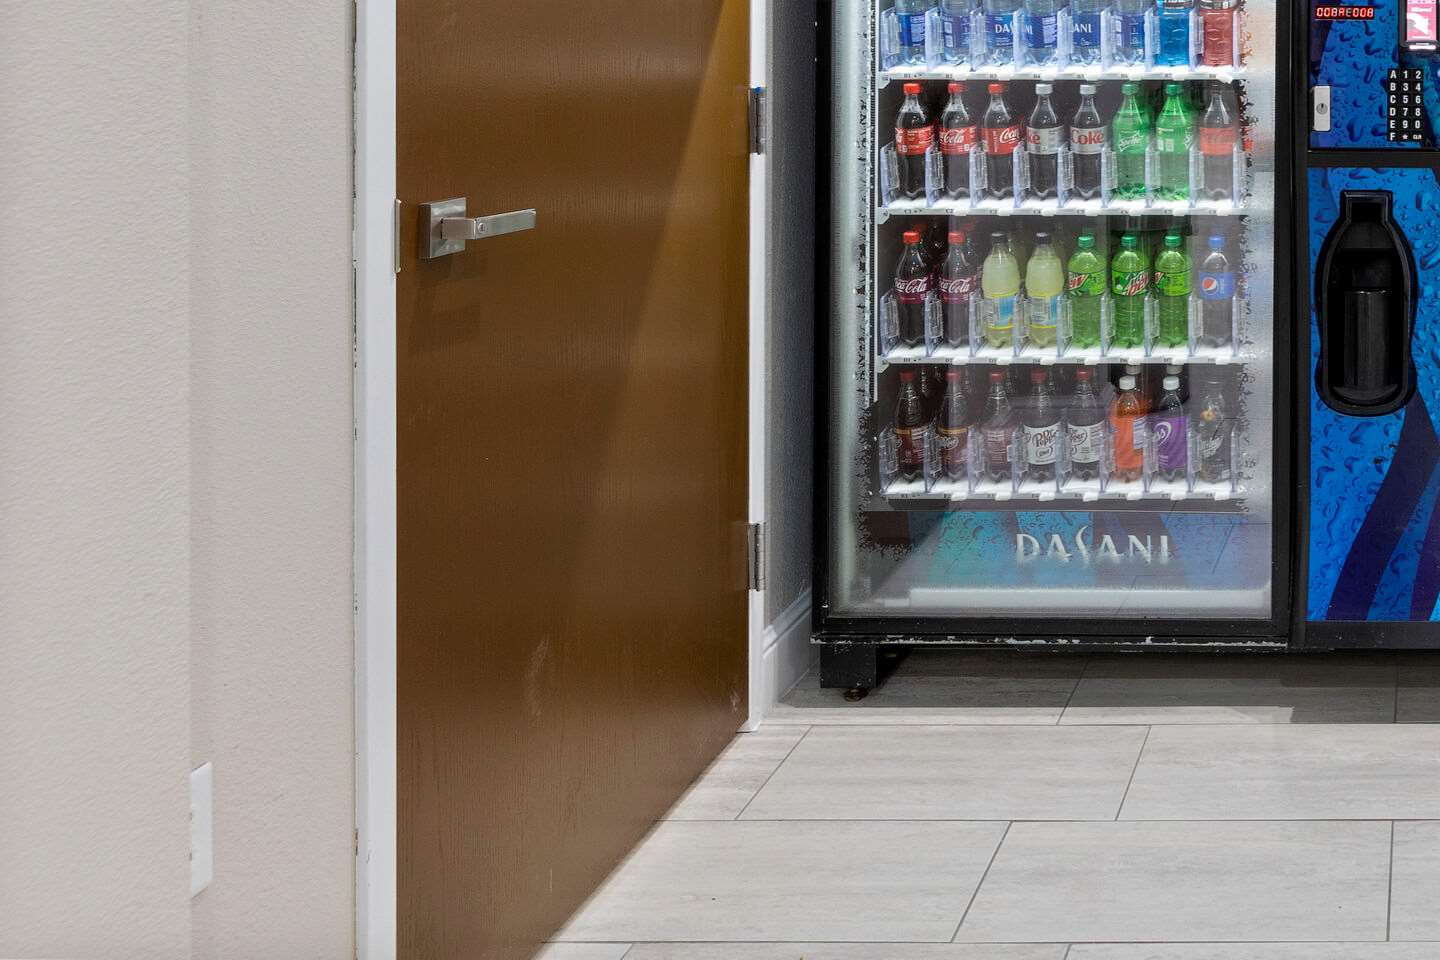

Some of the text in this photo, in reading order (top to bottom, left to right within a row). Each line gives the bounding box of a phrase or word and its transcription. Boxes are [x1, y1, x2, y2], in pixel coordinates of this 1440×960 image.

[1390, 70, 1422, 79] A 1 2
[1390, 83, 1421, 91] B 3 4
[1390, 95, 1421, 103] C 5 6
[1390, 108, 1421, 116] D 7 8
[1390, 120, 1396, 128] E
[1402, 120, 1408, 128] 9
[1015, 525, 1170, 567] DASANI
